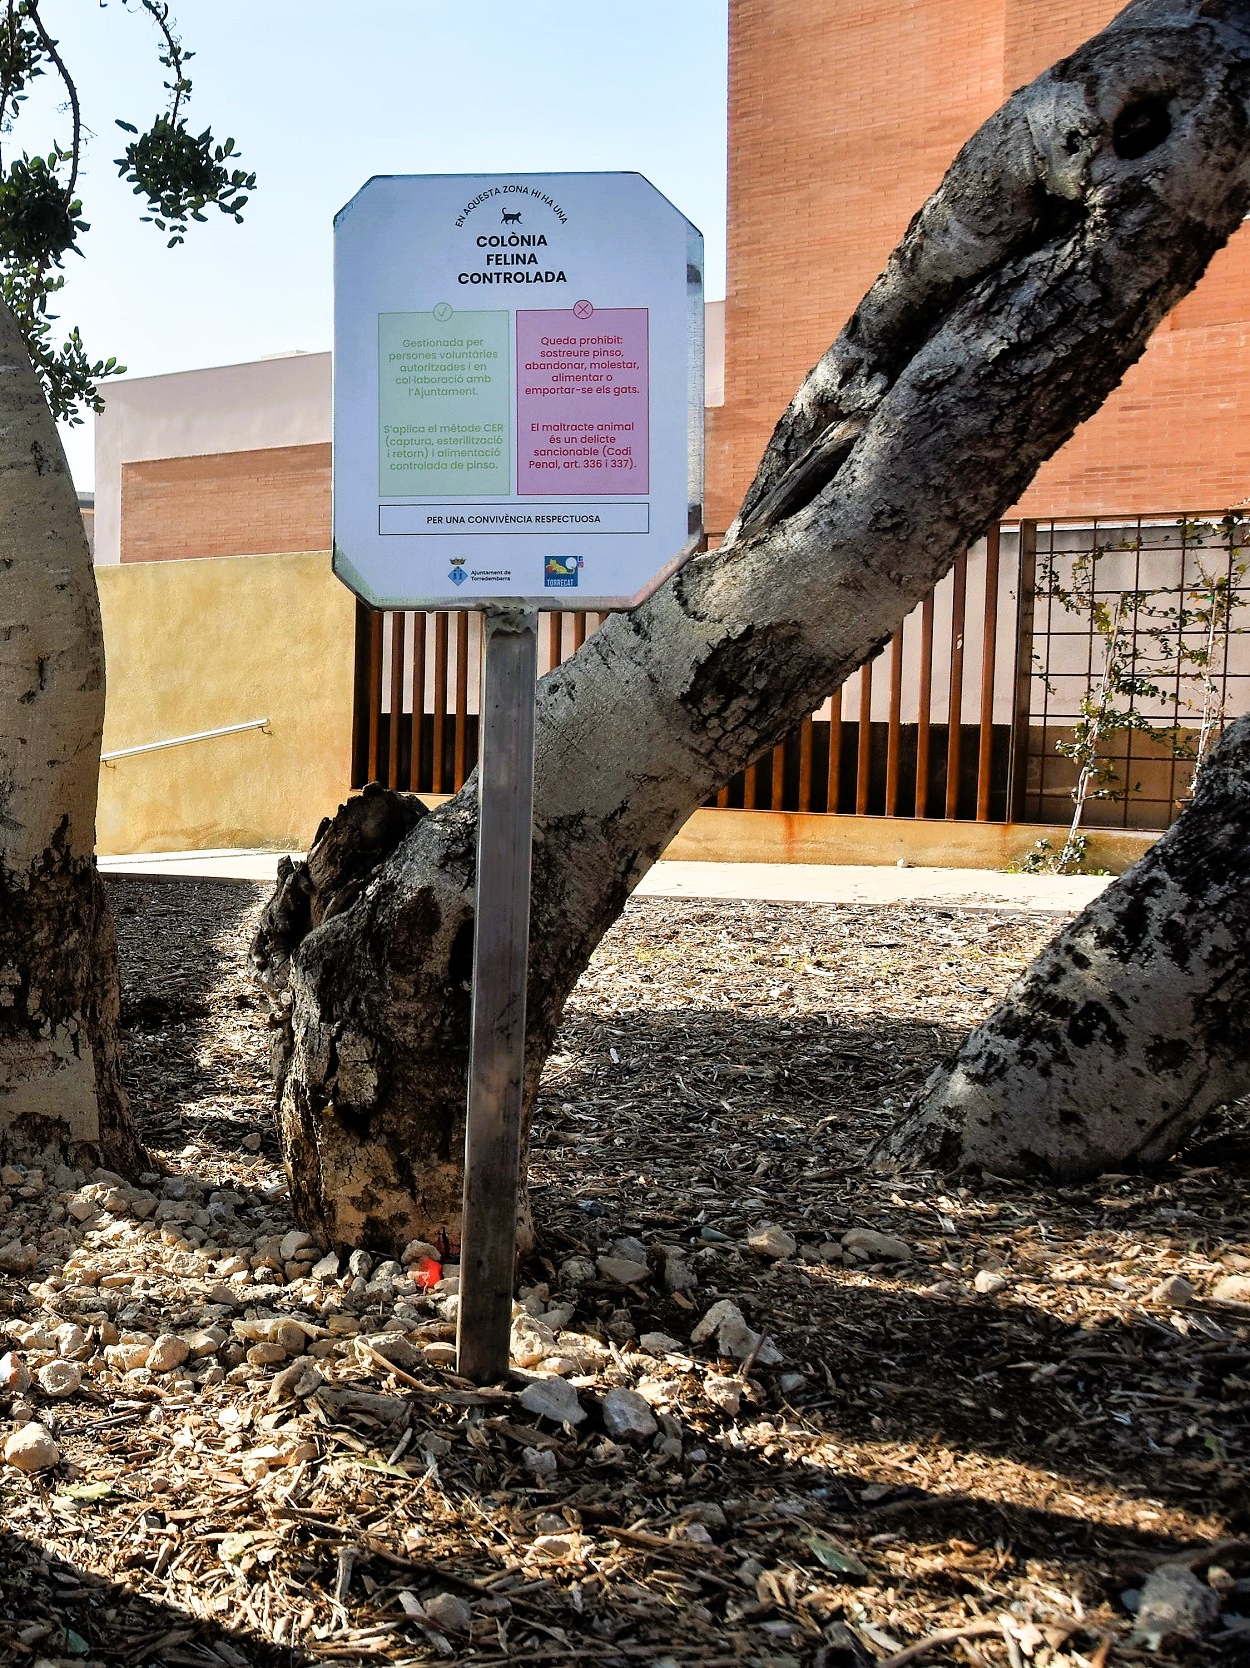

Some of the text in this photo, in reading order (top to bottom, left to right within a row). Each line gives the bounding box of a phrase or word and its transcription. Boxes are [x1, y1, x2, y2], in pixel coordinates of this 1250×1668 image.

[455, 185, 568, 227] EN AQUESTA ZONA HI HA UNA
[476, 232, 547, 247] COLÒNIA
[487, 253, 538, 265] FELINA
[458, 271, 567, 284] CONTROLADA
[402, 338, 484, 349] Gestionada per
[541, 335, 623, 346] Queda prohibit:
[389, 350, 436, 361] persones
[540, 348, 623, 359] sostreure pinso,
[400, 362, 465, 372] autoritzades
[467, 362, 471, 371] i
[525, 360, 640, 371] abandonar, molestar,
[467, 374, 492, 384] amb
[552, 373, 603, 382] alimentar
[525, 385, 640, 396] emportar-se els gats.
[428, 423, 437, 432] el
[484, 423, 503, 432] CER
[531, 422, 634, 431] El maltracte animal
[386, 435, 503, 446] (captura, esterilització
[550, 435, 562, 444] és
[580, 435, 616, 444] delicte
[387, 448, 501, 459] i retorn) i alimentació
[534, 445, 631, 458] sancionable (Codi
[390, 460, 498, 471] controlada de pinso.
[529, 458, 637, 470] Penal, art. 336 i 337).
[427, 514, 601, 524] PER UNA CONVIVÈNCIA RESPECTUOSA
